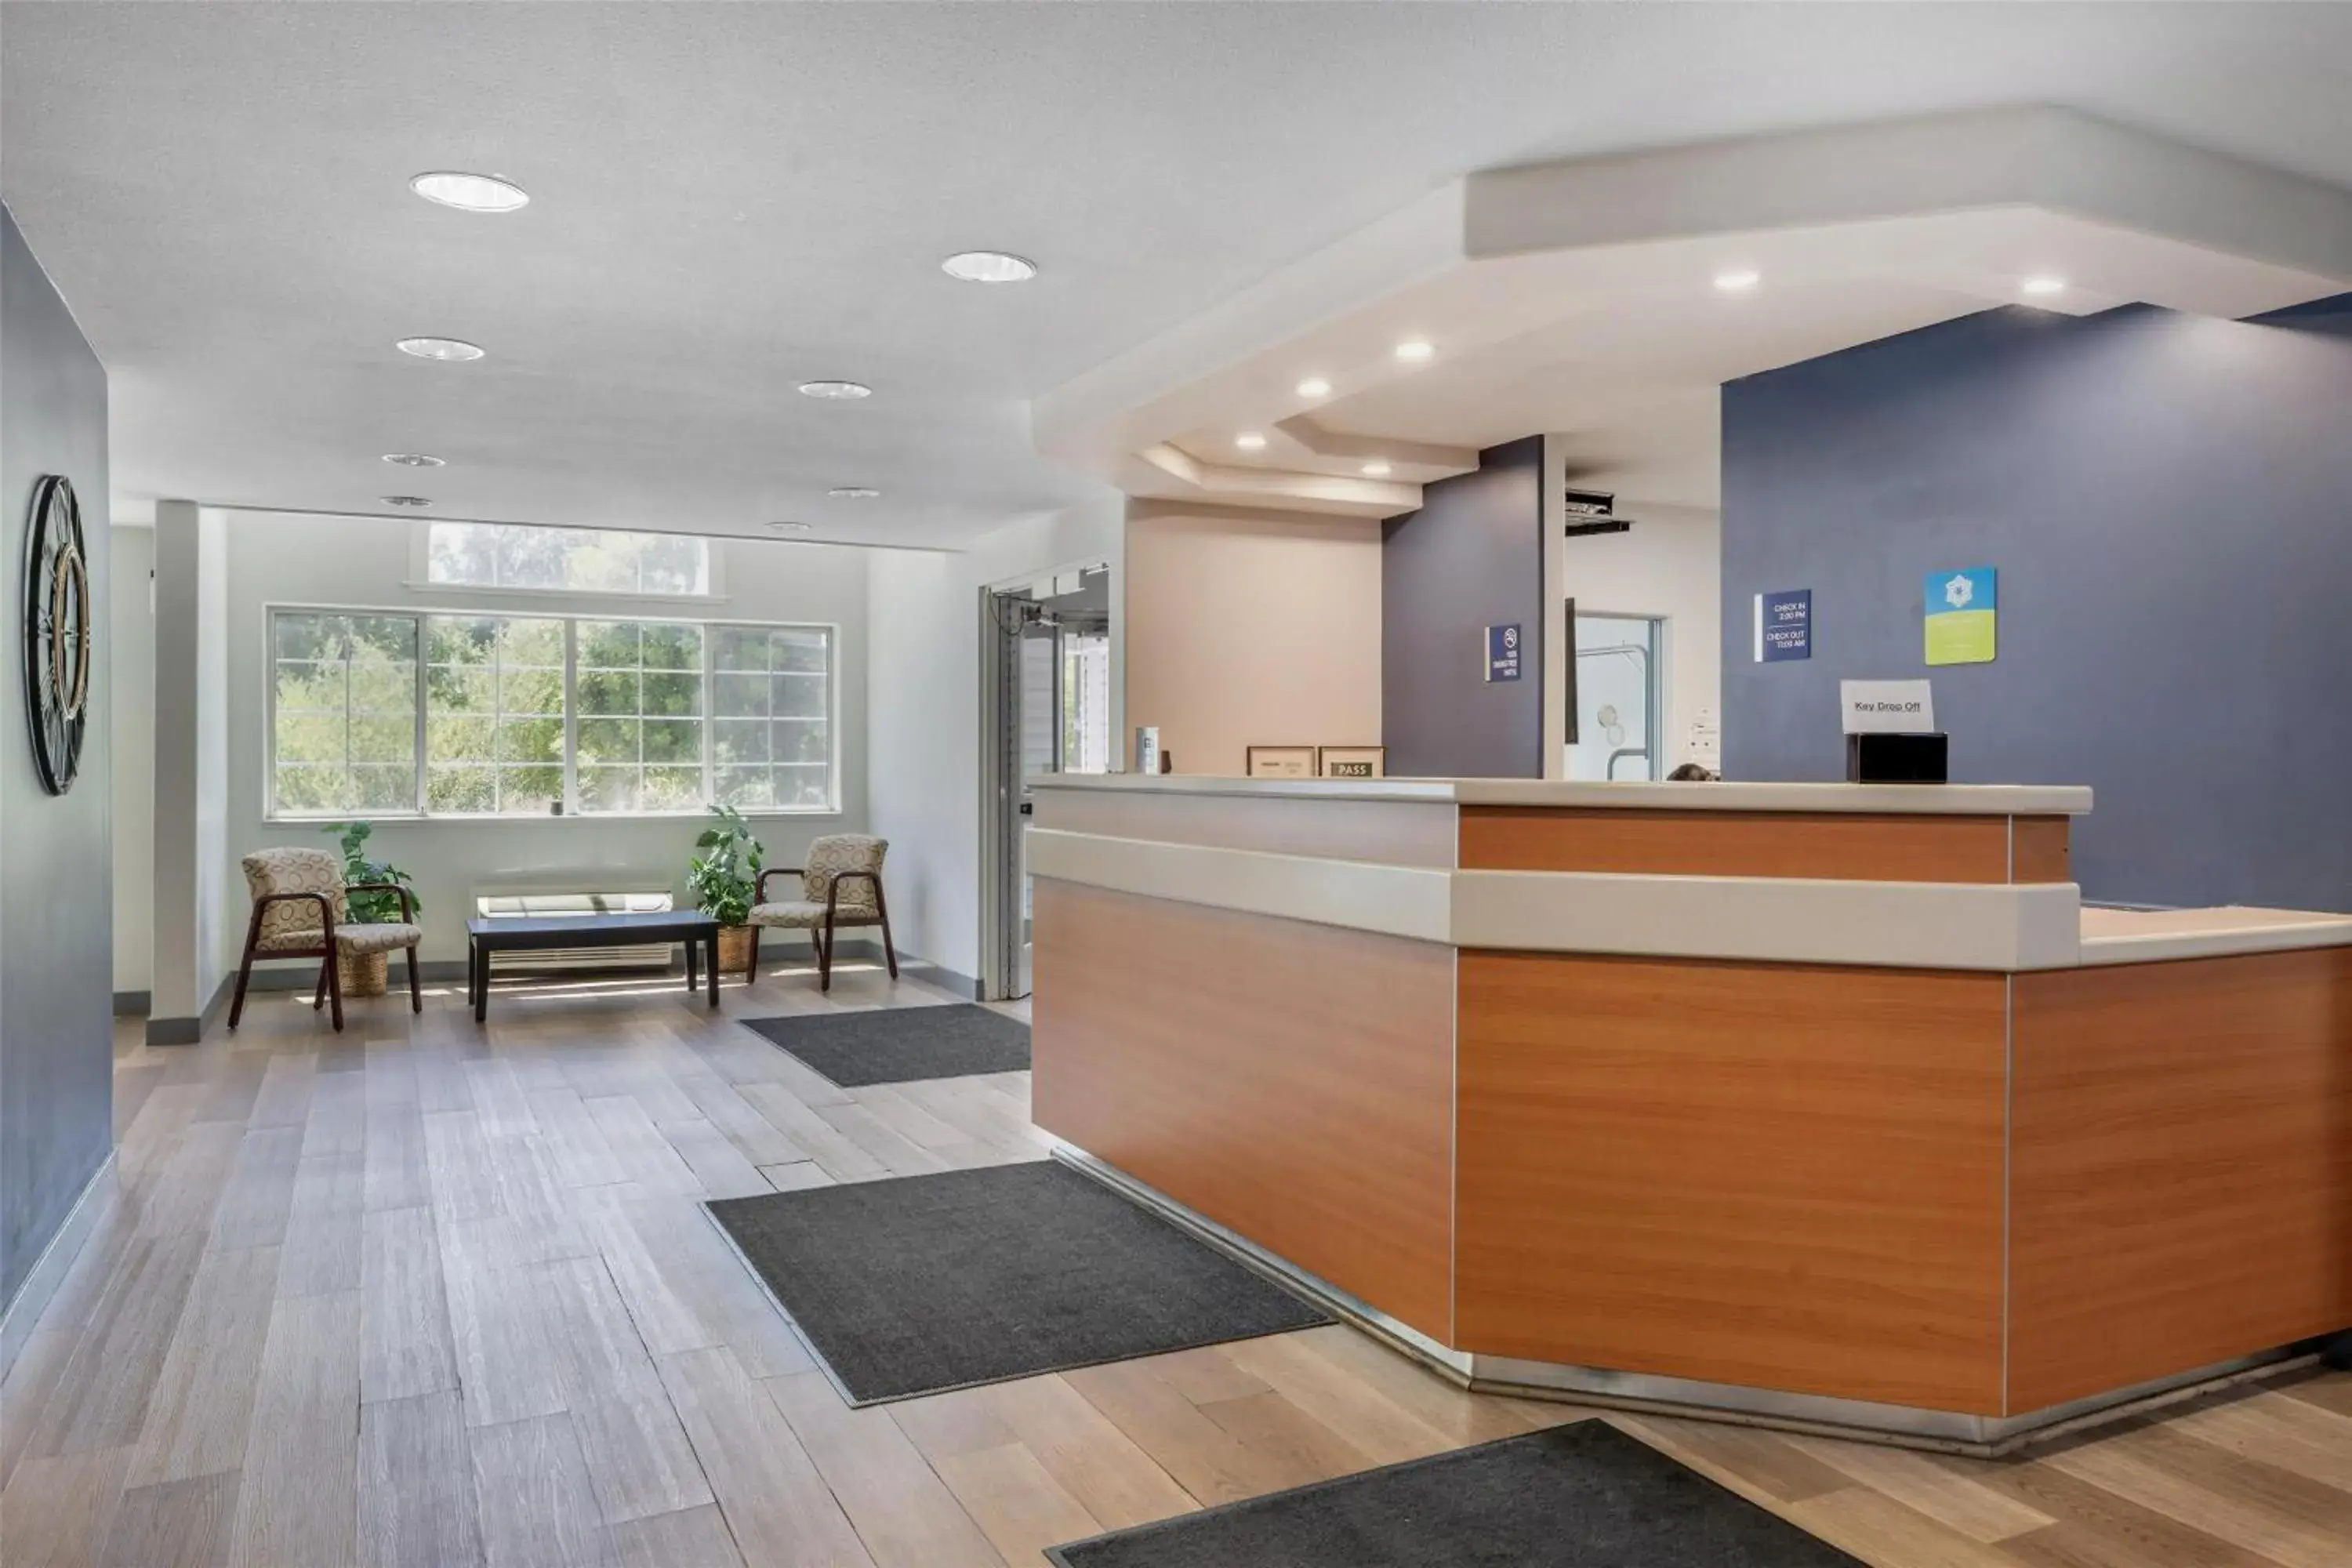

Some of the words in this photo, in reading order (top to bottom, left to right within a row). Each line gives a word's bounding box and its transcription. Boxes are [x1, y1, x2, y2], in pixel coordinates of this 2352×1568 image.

[1790, 630, 1805, 639] OUT
[1855, 702, 1875, 712] Key
[1878, 702, 1903, 713] Drop
[1904, 702, 1921, 713] Off
[1338, 764, 1367, 775] PASS
